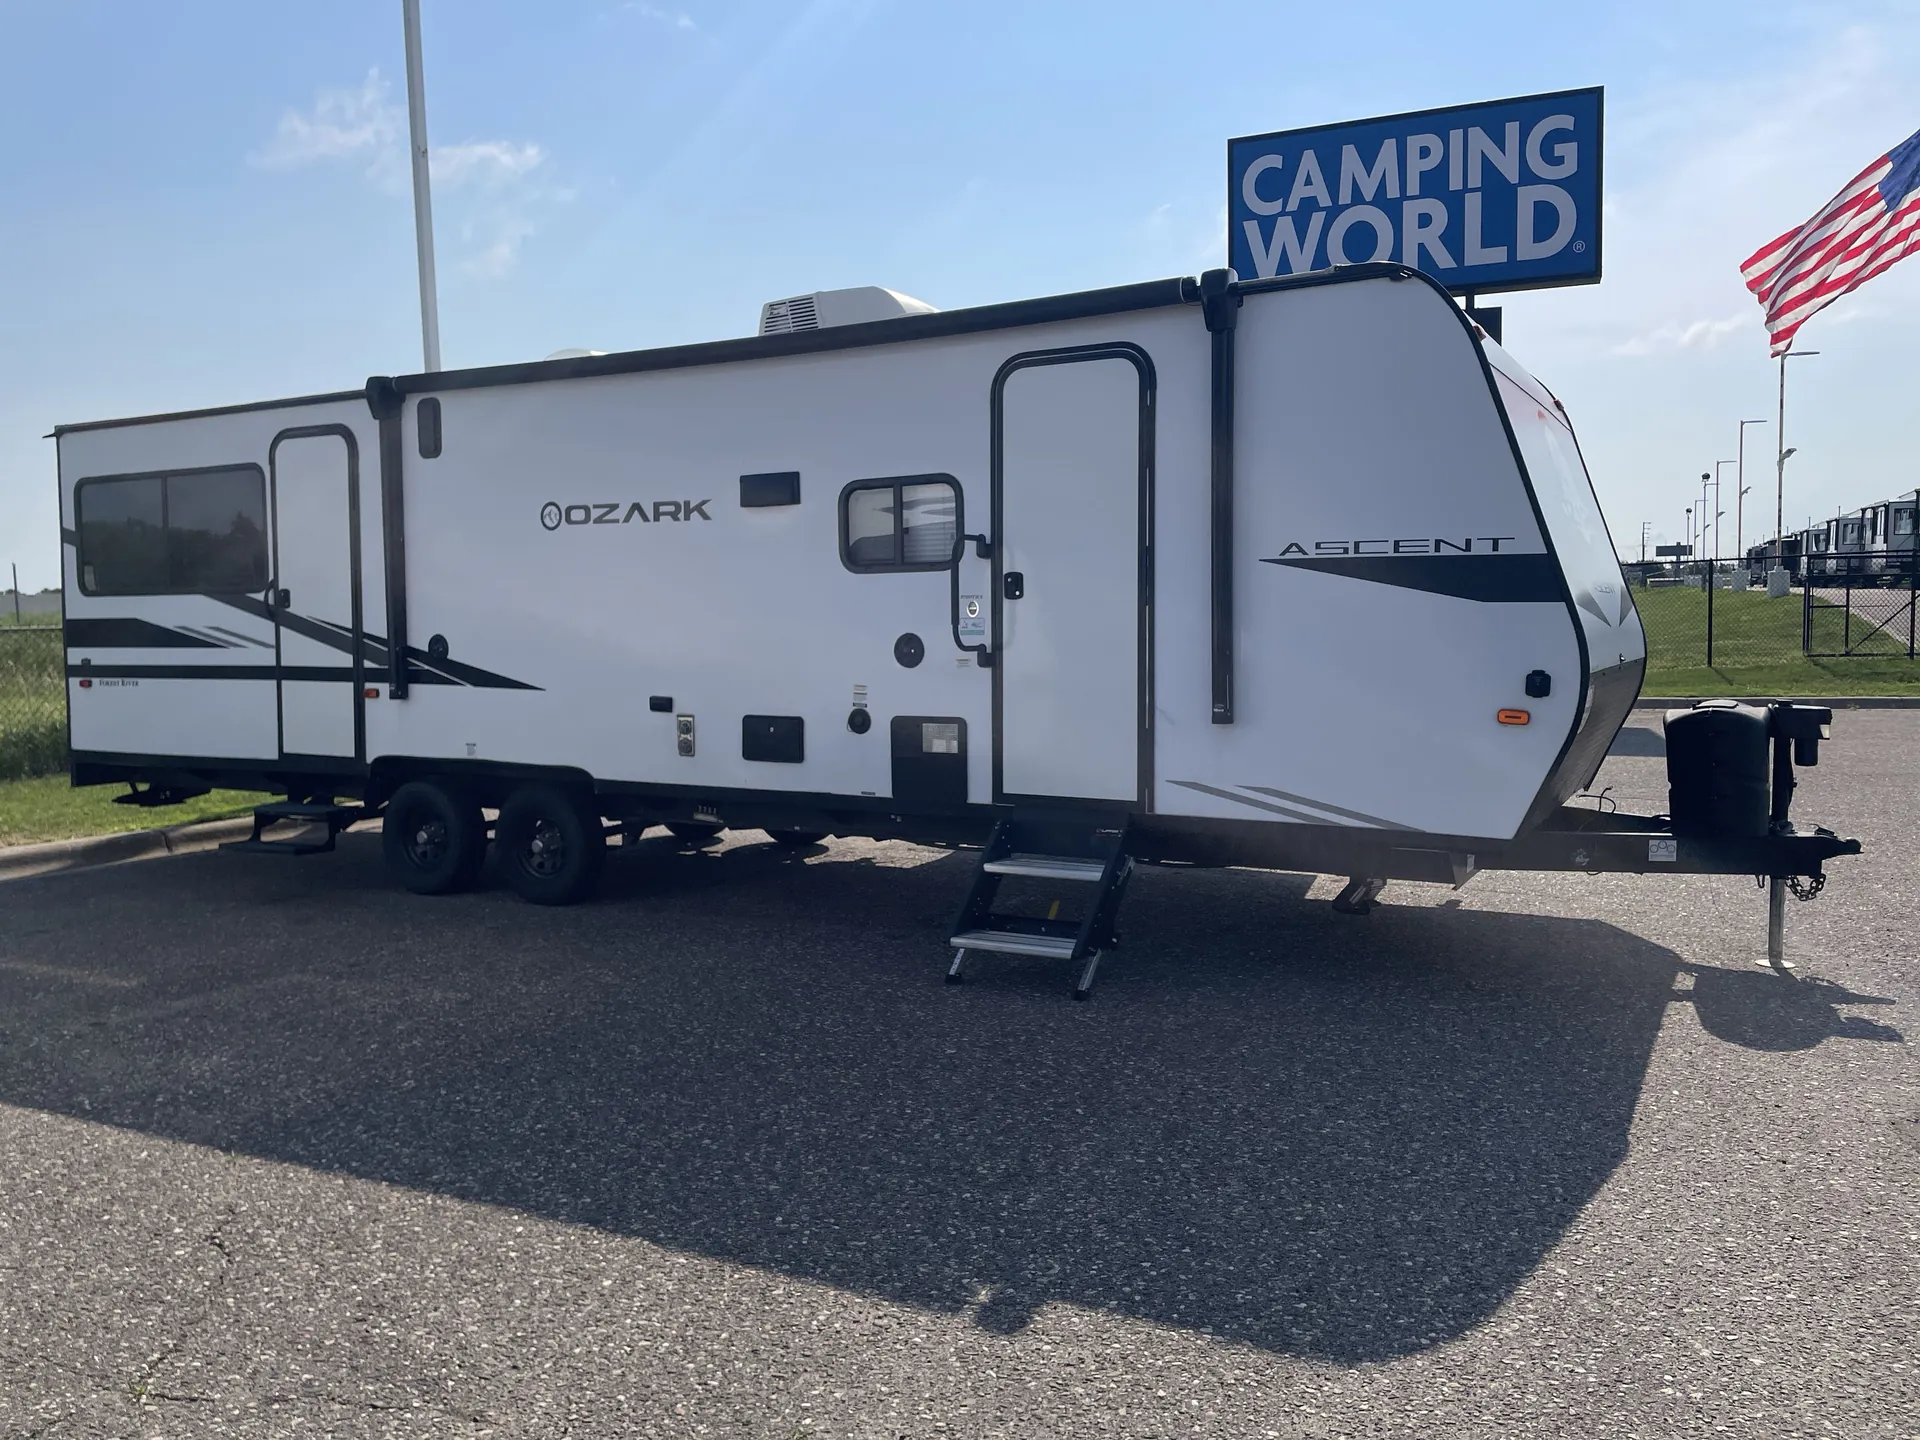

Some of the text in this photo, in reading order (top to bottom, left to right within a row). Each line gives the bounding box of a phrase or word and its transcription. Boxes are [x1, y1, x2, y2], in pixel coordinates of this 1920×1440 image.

[1242, 114, 1578, 216] CAMPING
[564, 499, 712, 525] OZARK
[1279, 537, 1515, 556] ASCENT
